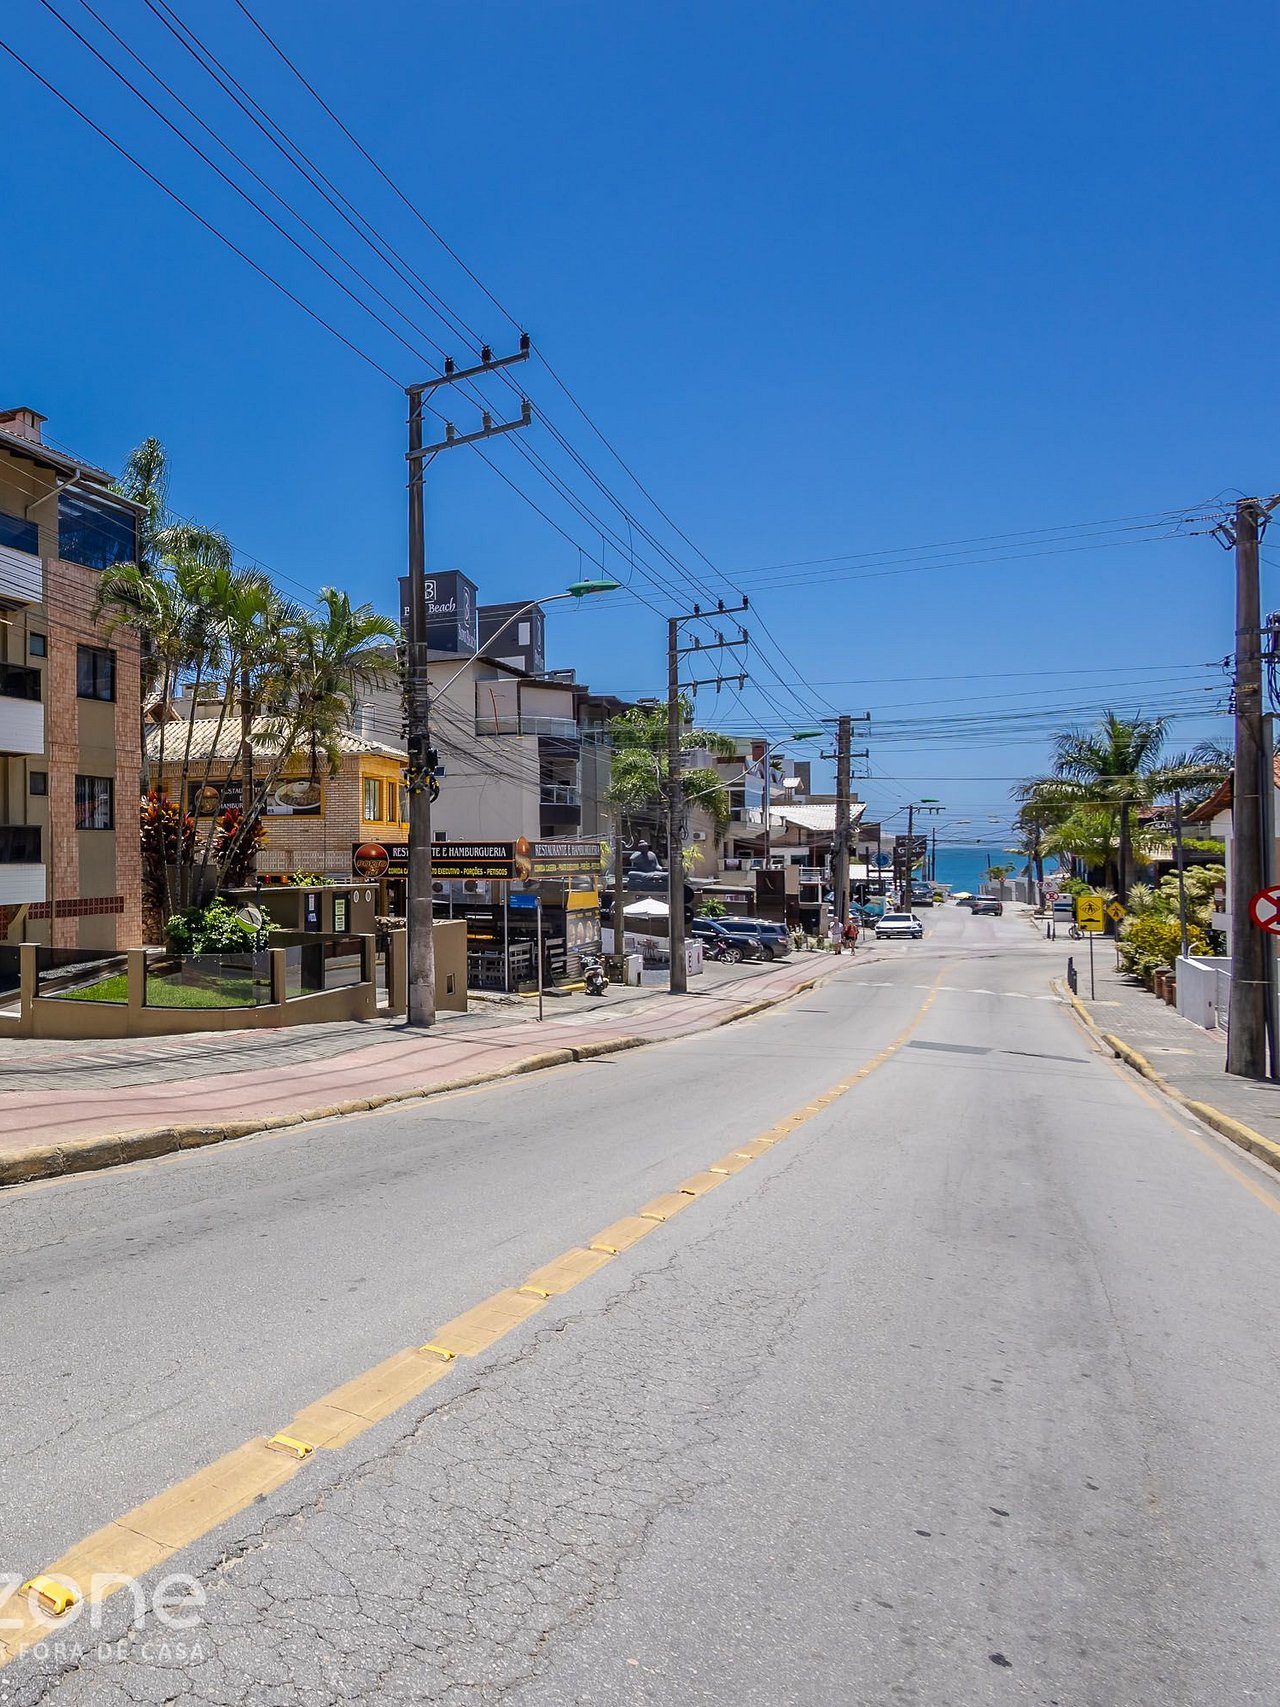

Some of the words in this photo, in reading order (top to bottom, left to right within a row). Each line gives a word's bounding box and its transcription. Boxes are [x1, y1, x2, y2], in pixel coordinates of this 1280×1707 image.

[428, 597, 456, 613] Beach
[442, 847, 448, 857] E
[449, 847, 507, 857] HAMBURGUERIA
[486, 868, 508, 876] PETISCOS
